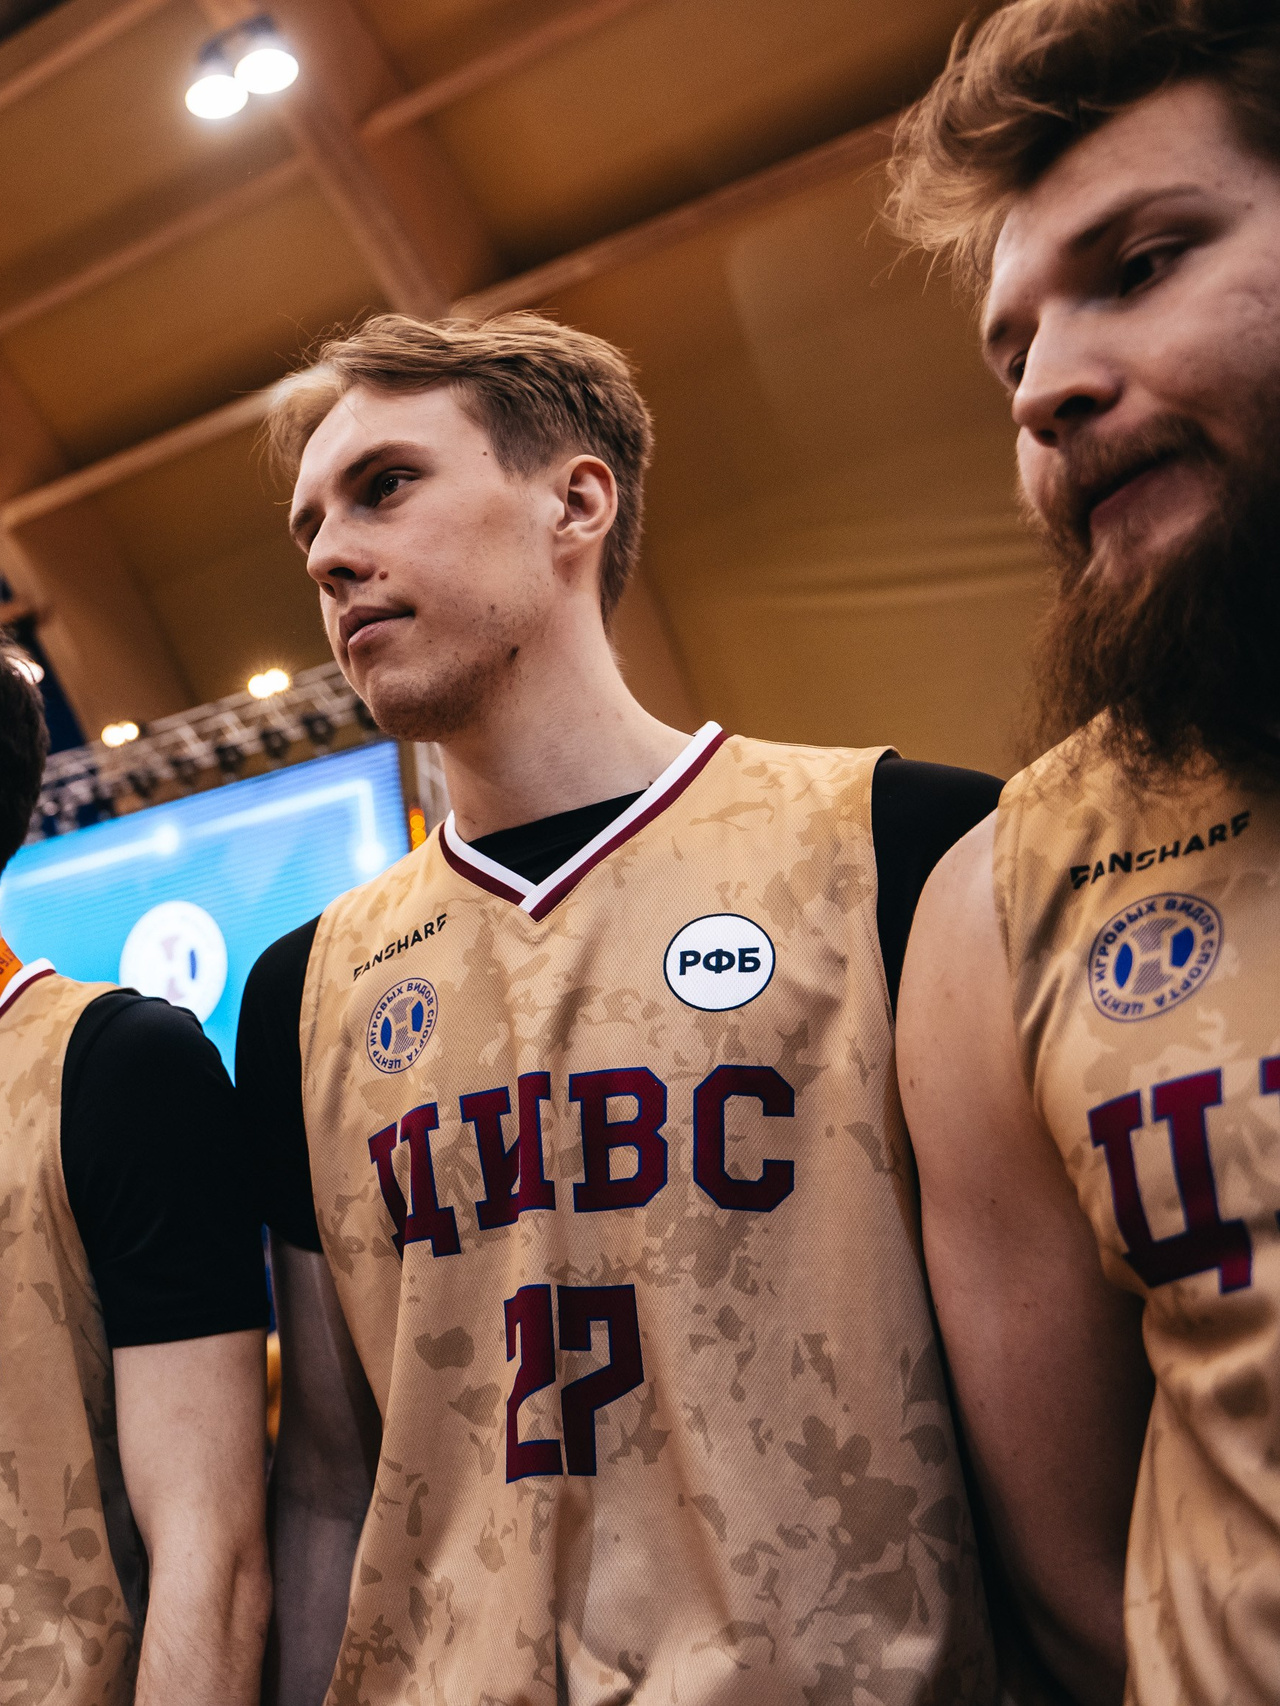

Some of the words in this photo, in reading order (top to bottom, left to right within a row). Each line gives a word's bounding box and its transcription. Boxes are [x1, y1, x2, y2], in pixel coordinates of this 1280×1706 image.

[1095, 900, 1157, 982] ИГРОВЫХ
[1164, 899, 1216, 936] ВИДОВ
[679, 947, 761, 976] РФБ
[1153, 939, 1214, 1007] СПОРТА
[369, 986, 404, 1047] ИГРОВЫХ
[406, 982, 435, 1007] ВИДОВ
[1096, 988, 1144, 1016] ЦЕНТР
[372, 1049, 402, 1070] ЦЕНТР
[405, 1010, 435, 1062] СПОРТА
[367, 1064, 795, 1262] ЦИВС
[1087, 1055, 1280, 1295] Ц
[504, 1283, 645, 1485] 27
